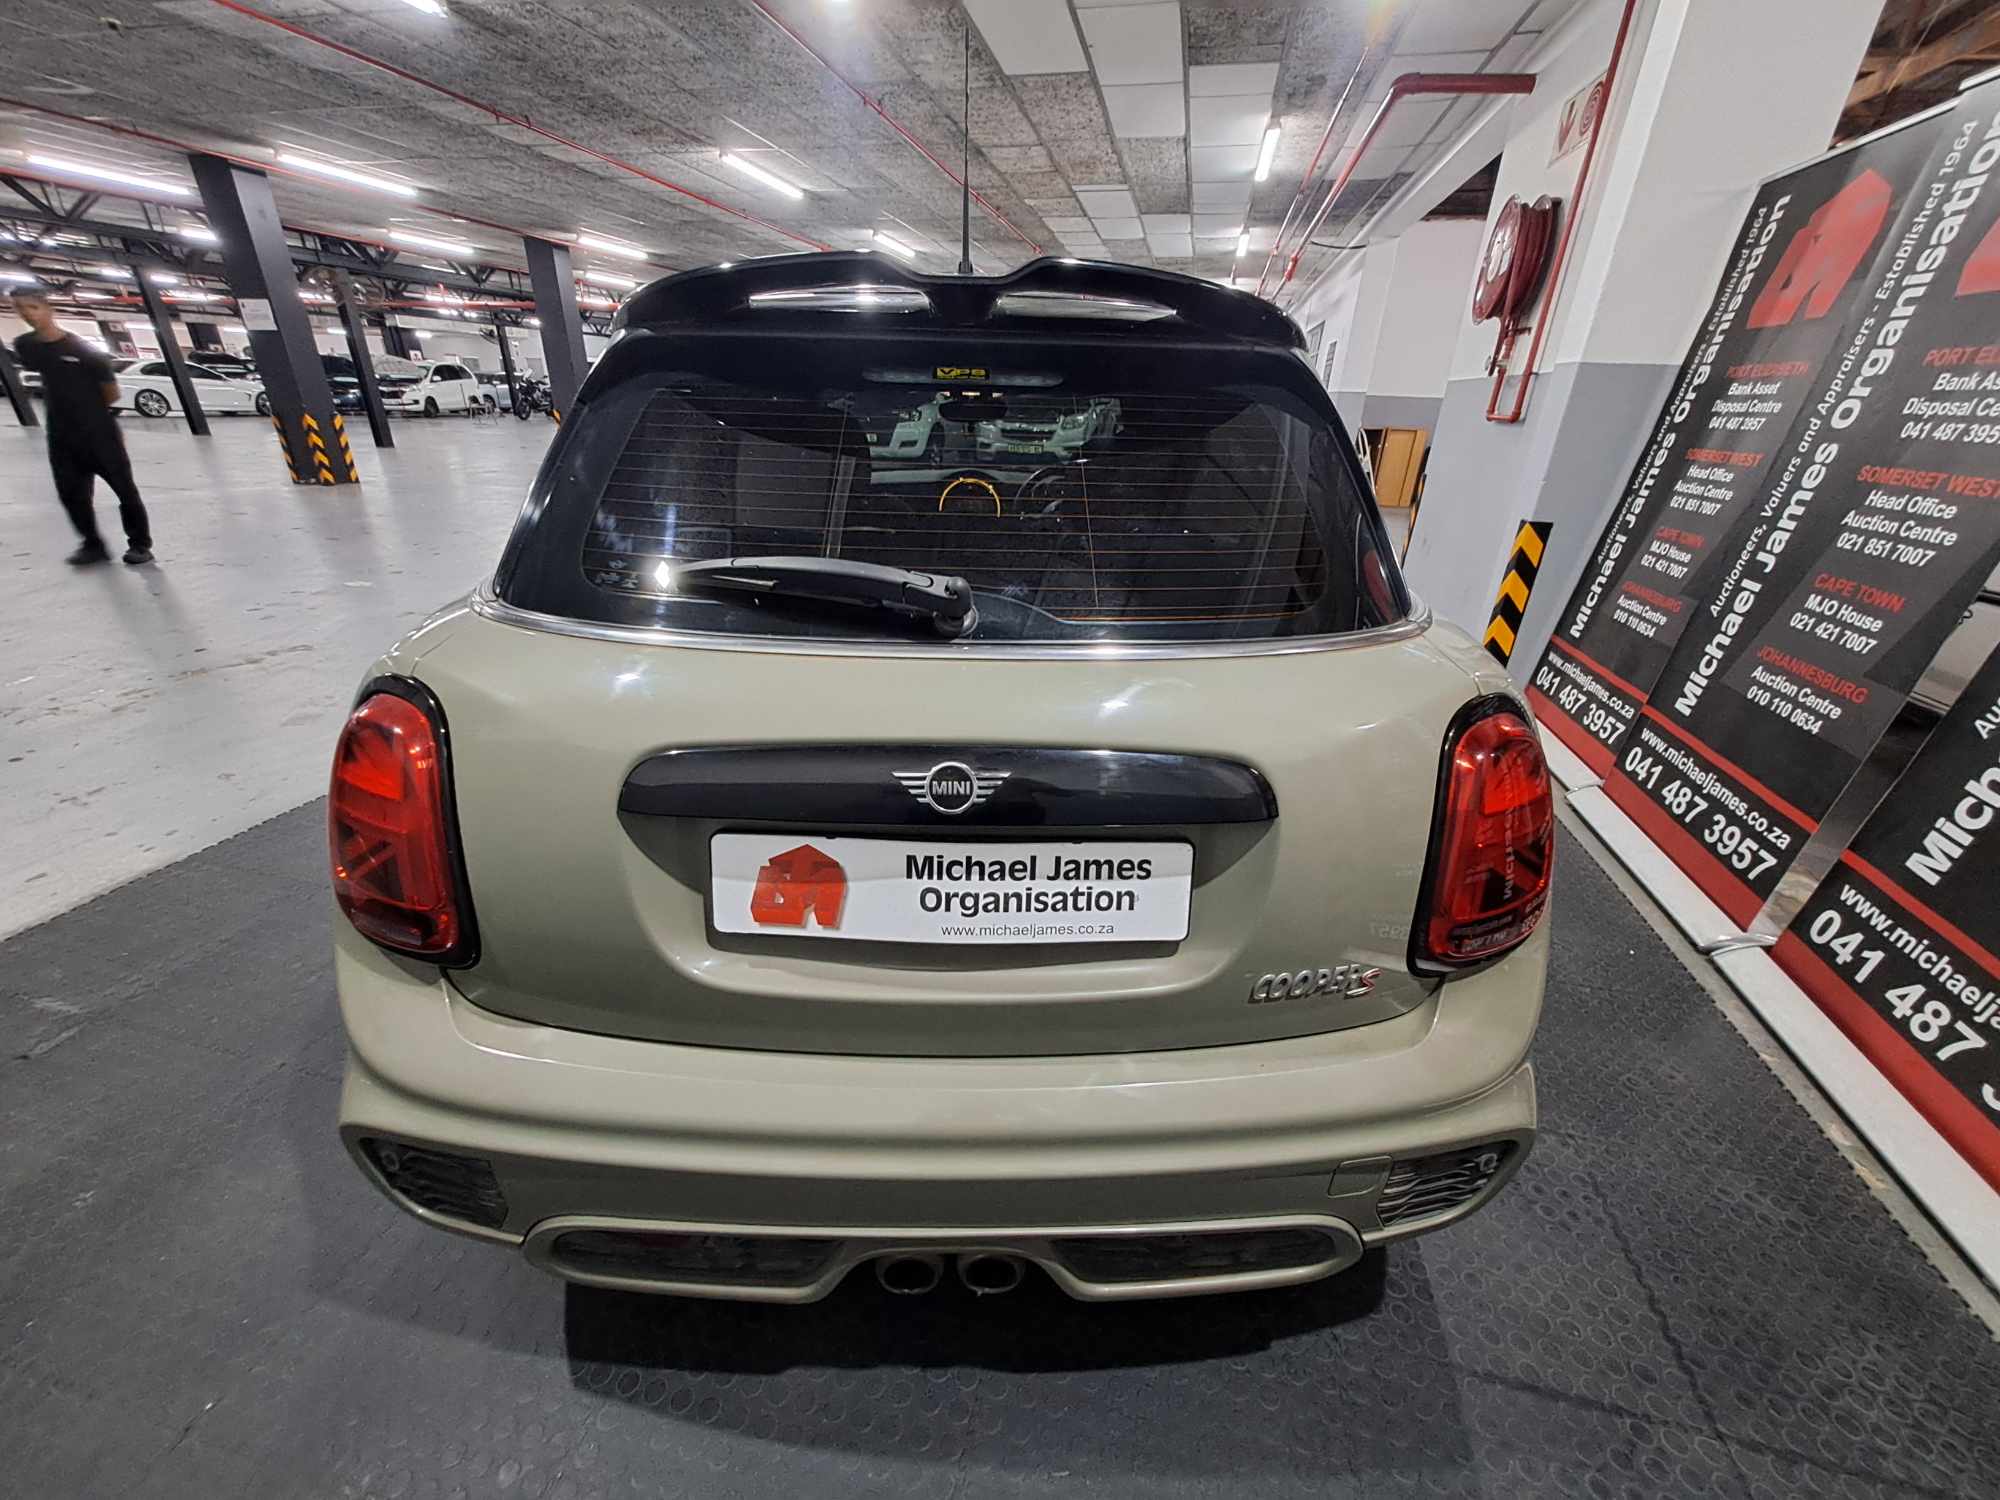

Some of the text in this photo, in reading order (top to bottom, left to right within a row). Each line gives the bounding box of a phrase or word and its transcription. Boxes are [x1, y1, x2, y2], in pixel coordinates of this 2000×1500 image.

[1709, 524, 1767, 617] Auctioneers,
[1760, 455, 1801, 518] Valuers
[1798, 417, 1822, 453] and
[1817, 316, 1876, 415] Appraisers
[1875, 183, 1946, 300] Established
[1938, 120, 1979, 177] 1964
[1922, 347, 1977, 367] PORT
[1728, 381, 1782, 395] Bank Asset
[1933, 371, 1981, 391] Bank
[1569, 534, 1628, 639] Michael
[1625, 432, 1676, 528] James
[1673, 194, 1792, 423] Organisation
[1748, 399, 1782, 413] Centre
[1903, 397, 1977, 419] Disposal
[1901, 421, 2000, 444] 041 487 395
[1687, 465, 1735, 482] Head Office
[1856, 464, 1948, 490] SOMERSET
[1674, 480, 1734, 500] Auction Centre
[1864, 489, 1958, 520] Head Office
[1698, 500, 1722, 516] 7007
[1841, 509, 1958, 546] Auction Centre
[1649, 540, 1692, 563] MJO House
[1836, 531, 1936, 568] 021 851 7007
[1666, 563, 1688, 579] 7007
[1674, 578, 1762, 717] Michael
[1756, 442, 1839, 573] James
[1814, 573, 1906, 614] CAPE TOWN
[1642, 606, 1667, 626] Centre
[1804, 594, 1884, 633] MJO House
[1790, 612, 1879, 656] 021 421 7007
[1547, 651, 1634, 719] www.michaeljames.co.za
[1757, 646, 1868, 704] JOHANNESBURG
[1536, 665, 1626, 745] 041 487 3957
[1750, 665, 1842, 720] Auction Centre
[1747, 685, 1823, 736] 010 110 0634
[931, 780, 971, 796] MINI
[1640, 727, 1792, 850] www.michaeljames.co.za
[1625, 746, 1778, 881] 041 487 3957
[1904, 754, 2000, 887] Mich
[905, 854, 1152, 881] Michael James
[919, 886, 1136, 918] Organisation
[941, 923, 1115, 938] www.michaeljames.co.za
[1809, 909, 1987, 1061] 041 487
